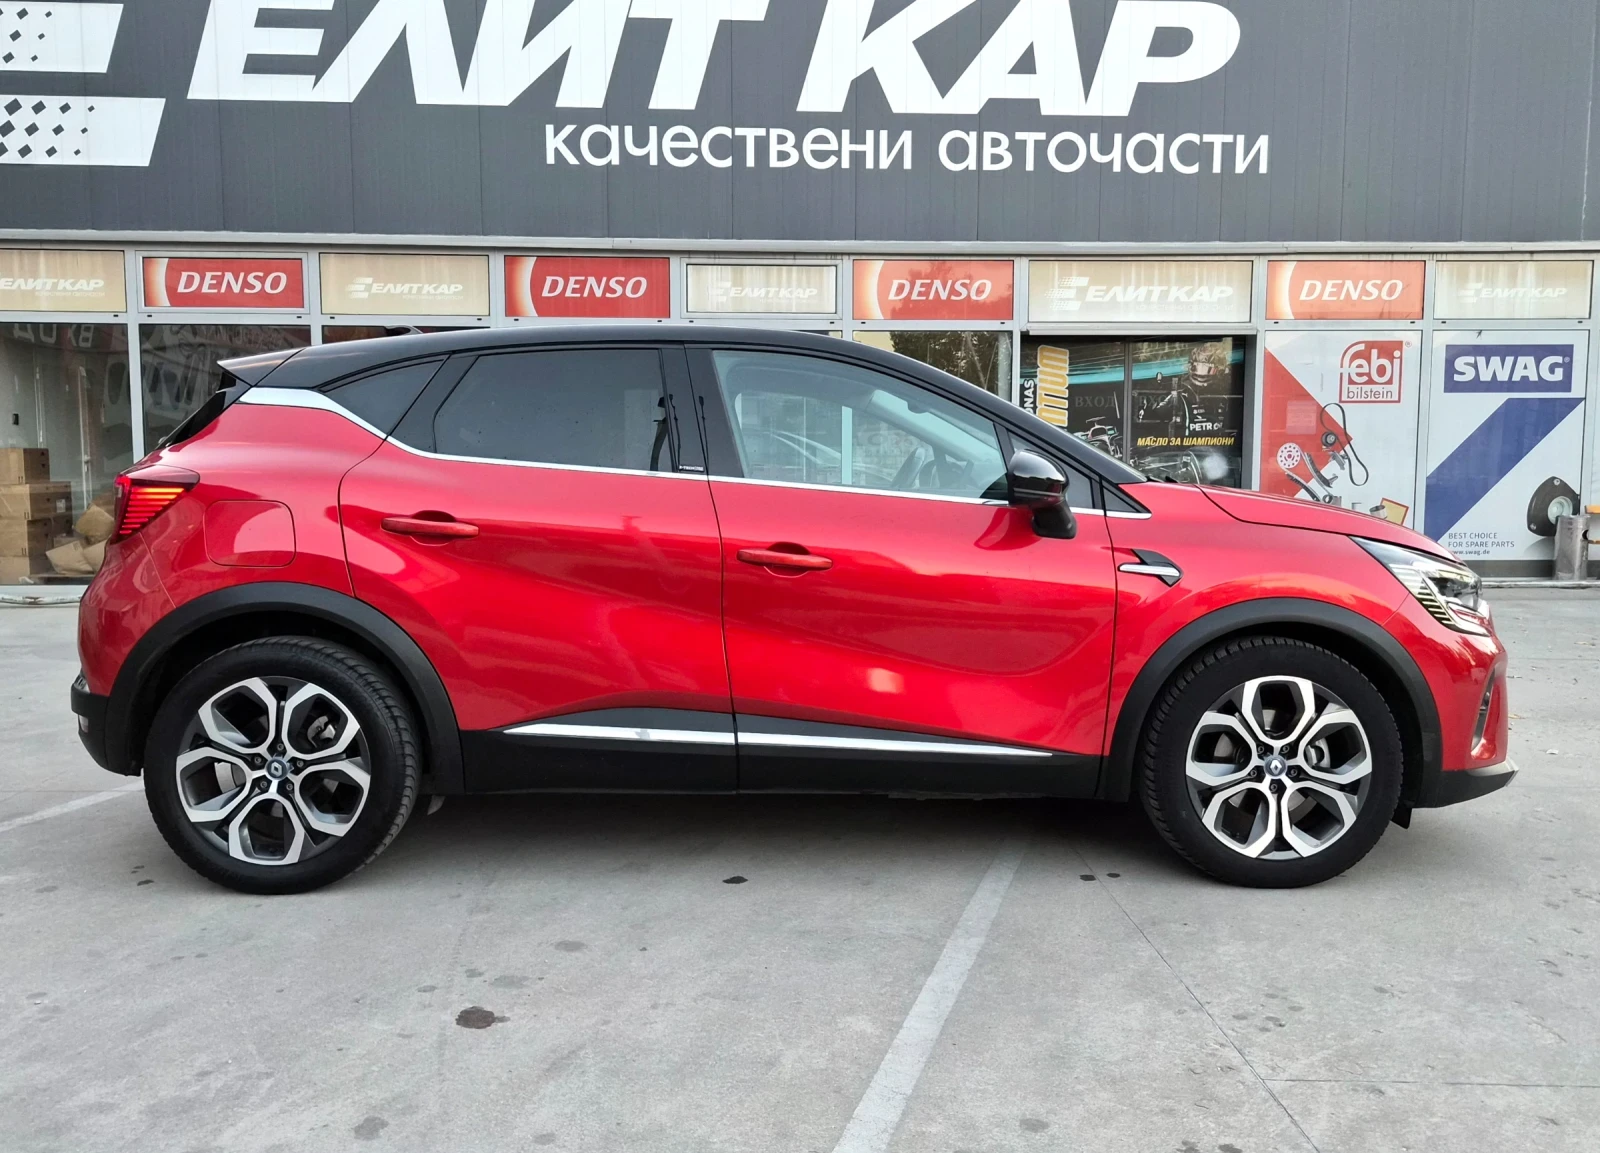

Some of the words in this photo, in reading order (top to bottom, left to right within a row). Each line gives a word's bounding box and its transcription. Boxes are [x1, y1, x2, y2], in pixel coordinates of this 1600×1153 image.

[187, 0, 770, 110] ЕЛИТ
[797, 0, 1241, 117] КАР
[545, 123, 913, 170] качествени
[938, 129, 1269, 175] авточасти
[177, 271, 288, 294] DENSO
[541, 275, 648, 298] DENSO
[888, 279, 992, 301] DENSO
[1299, 279, 1403, 301] DENSO
[1340, 343, 1401, 386] febi
[1453, 355, 1564, 382] SWAG
[1346, 386, 1393, 400] bilstein
[1136, 437, 1168, 447] МАСЛО
[1169, 437, 1181, 446] ЗА
[1183, 437, 1235, 447] ШАМПИОНИ
[1448, 532, 1467, 540] BEST
[1469, 532, 1498, 540] CHOICE
